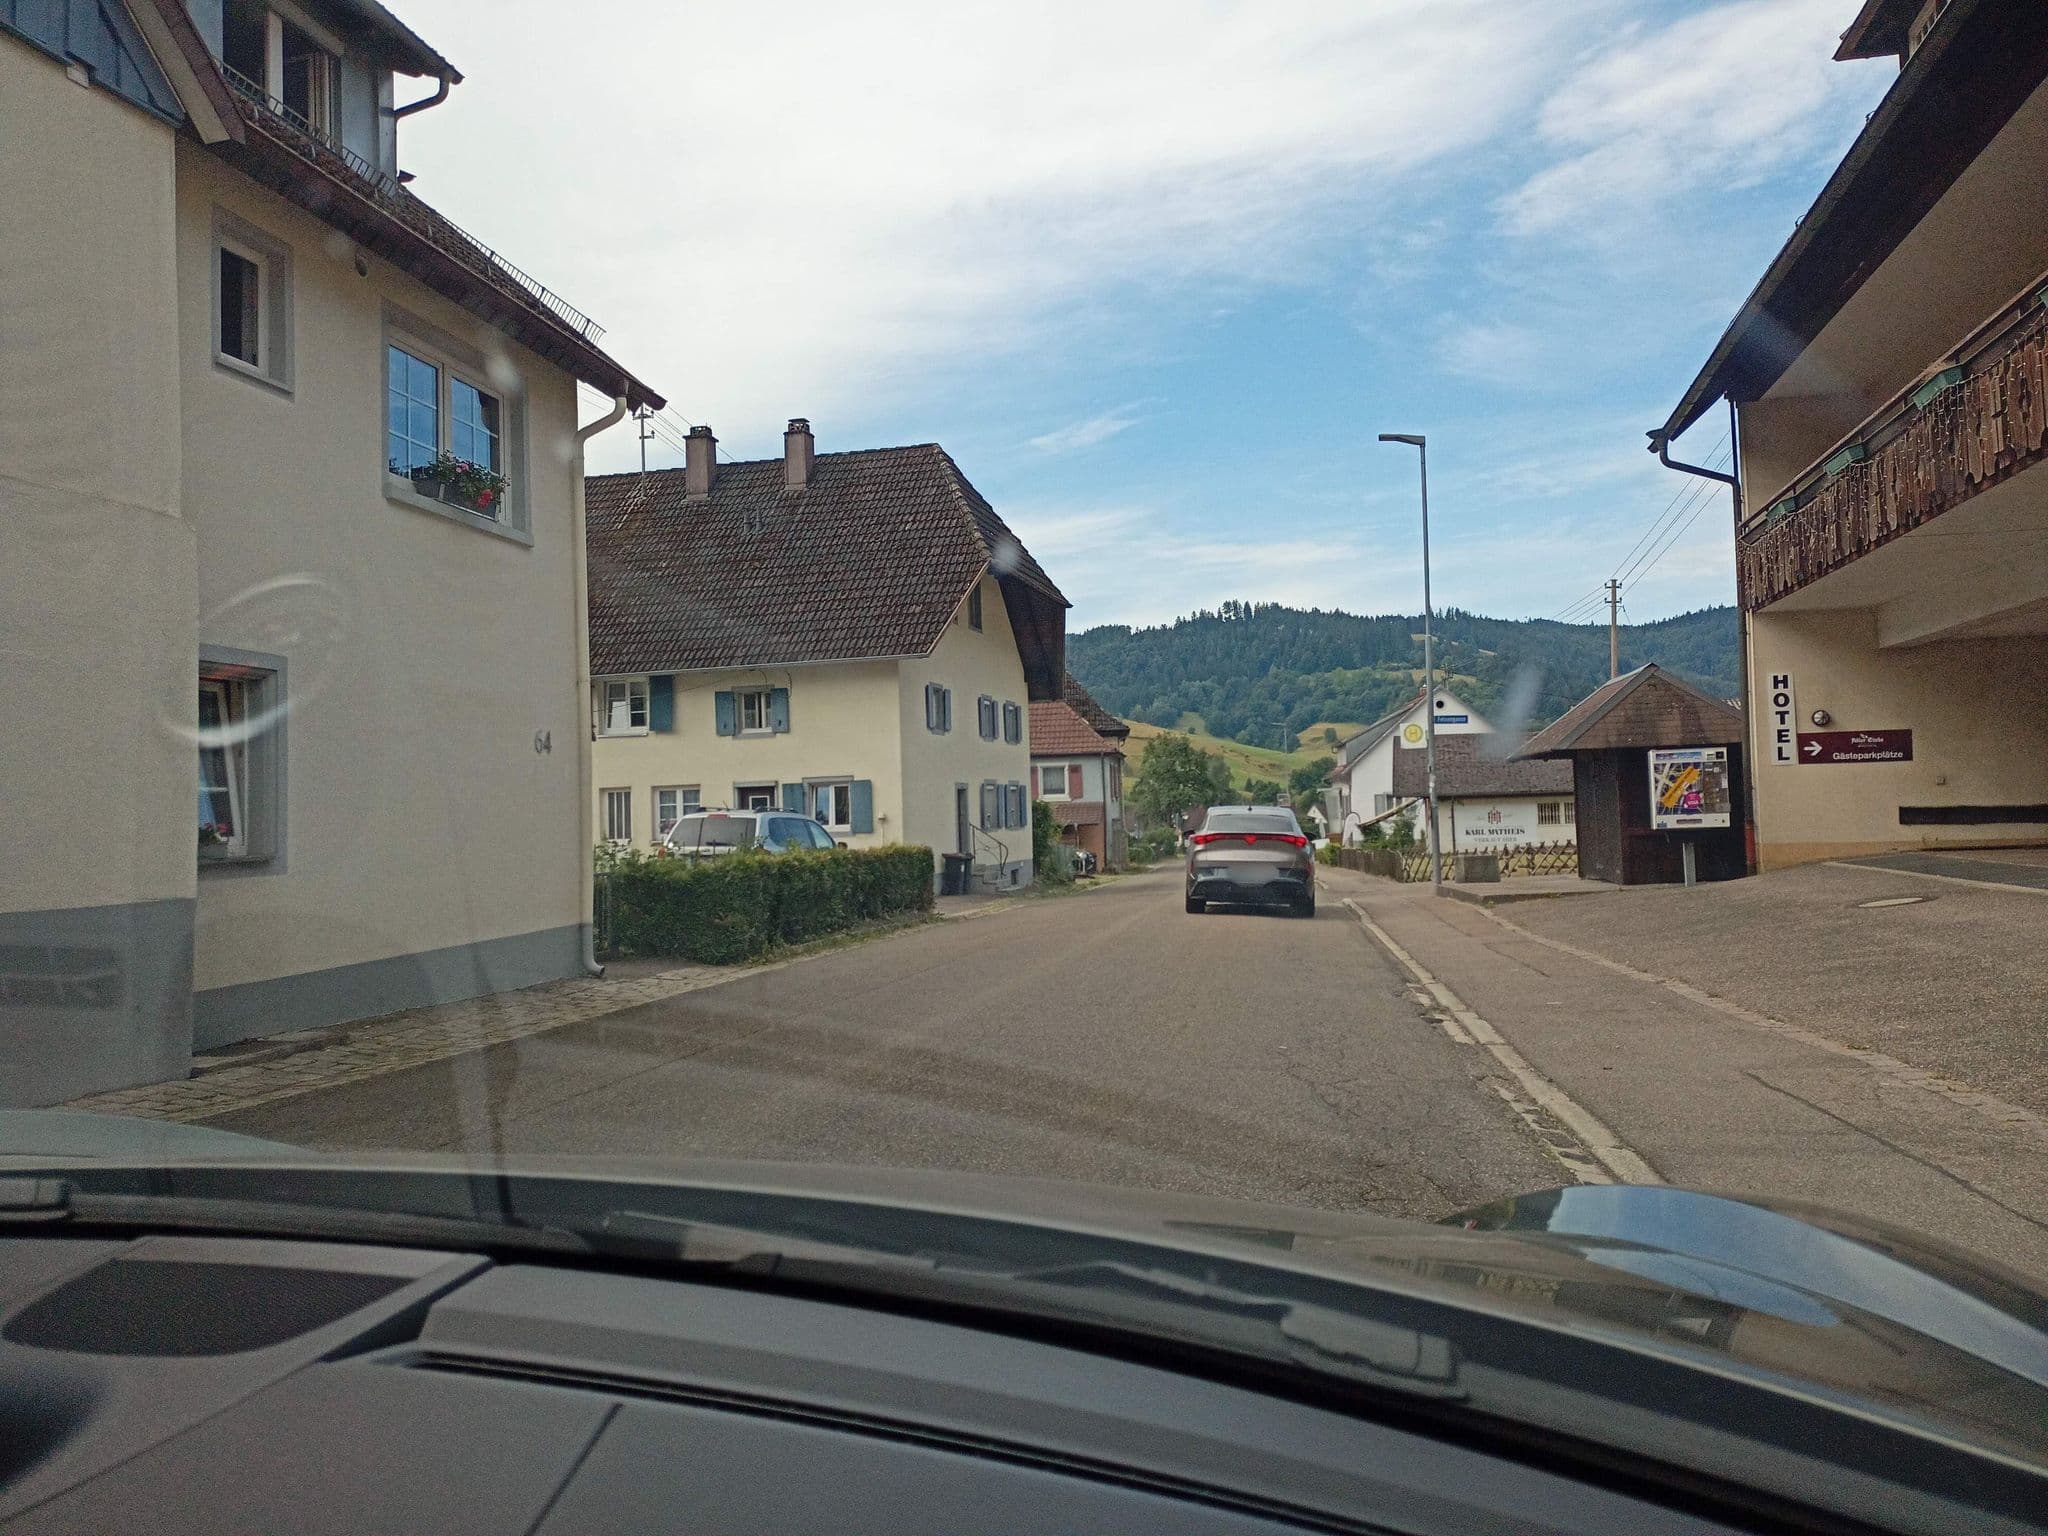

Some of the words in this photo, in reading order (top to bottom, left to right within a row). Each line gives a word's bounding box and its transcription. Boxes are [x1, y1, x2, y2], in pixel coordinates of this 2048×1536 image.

[1773, 675, 1791, 761] HOTEL
[534, 729, 552, 754] 64
[1832, 751, 1903, 760] Gästeparkplätze
